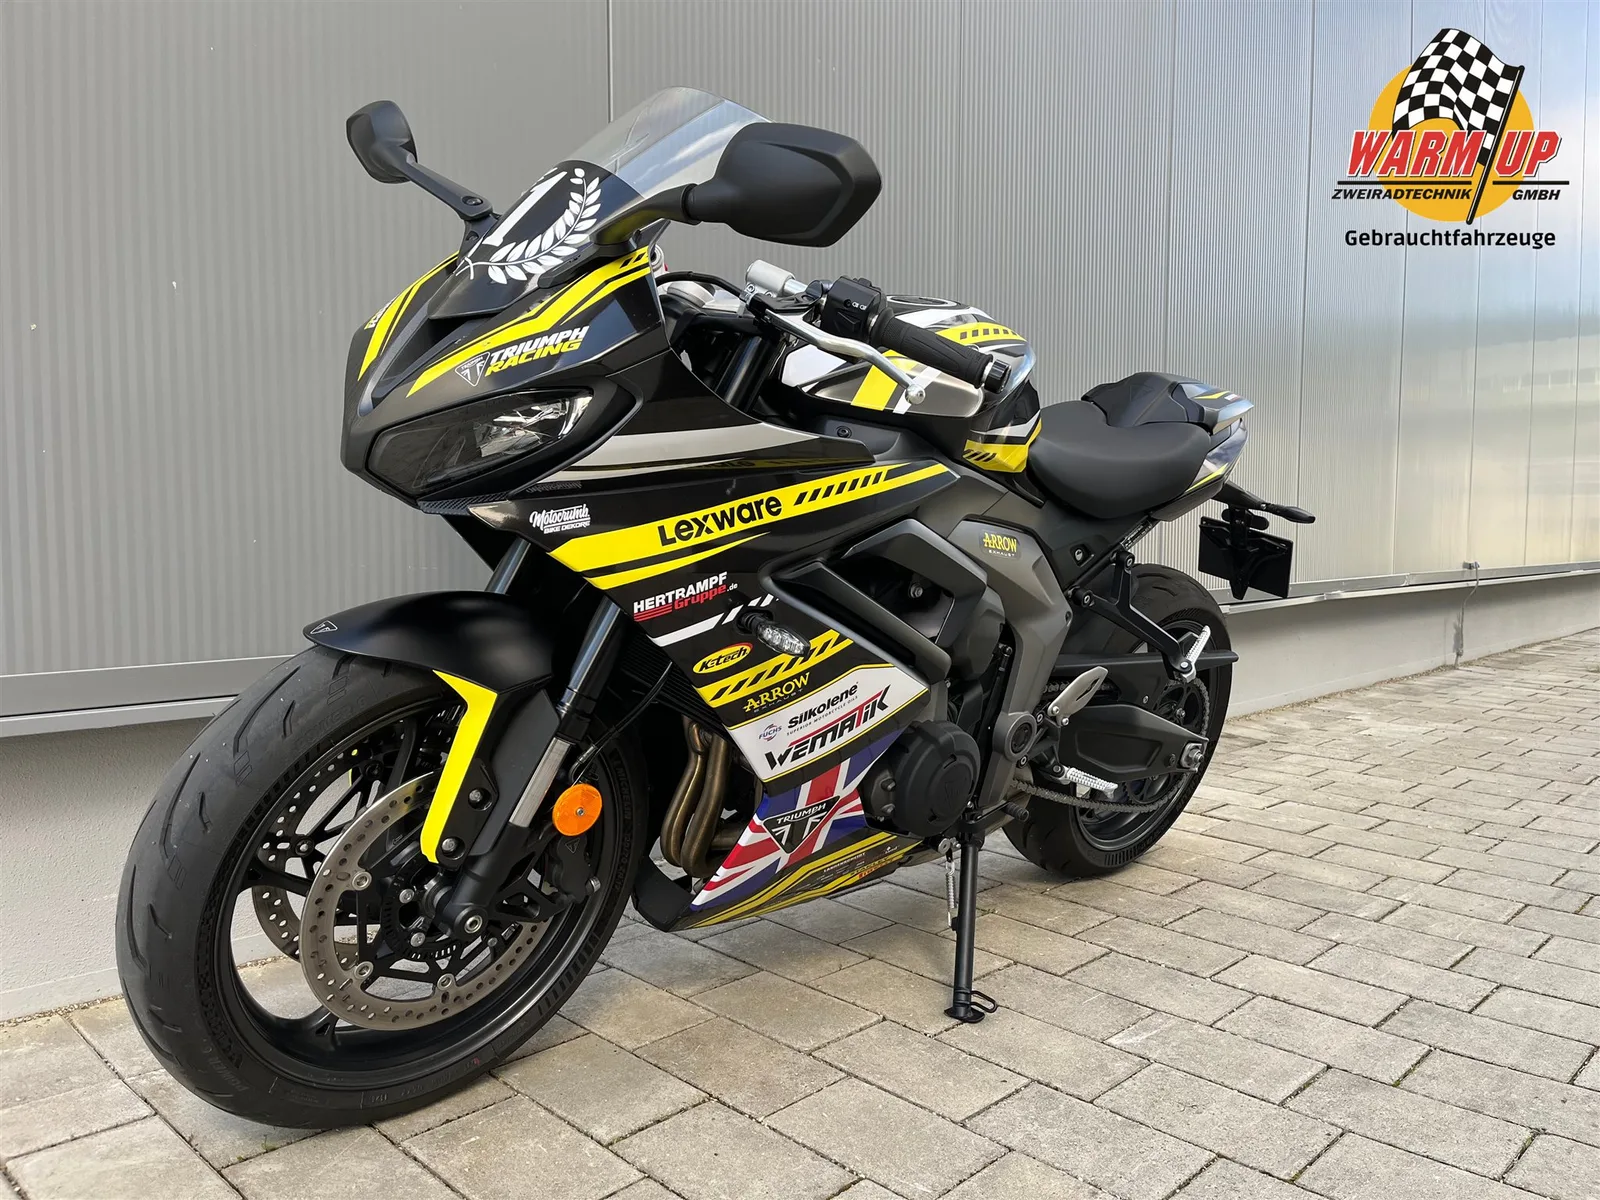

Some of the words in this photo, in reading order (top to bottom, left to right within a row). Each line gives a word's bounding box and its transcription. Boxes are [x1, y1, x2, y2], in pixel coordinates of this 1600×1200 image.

[484, 338, 583, 378] RACING
[489, 325, 590, 365] TRIUMPH
[543, 526, 561, 535] BIKE
[561, 520, 591, 531] DEKORE
[657, 496, 783, 547] Lexware
[982, 532, 1017, 553] ARROW
[633, 571, 728, 614] HERTRAMPF
[742, 671, 810, 713] ARROW
[787, 681, 859, 729] Silkolene
[758, 725, 782, 740] FUCHS
[786, 721, 812, 737] SUPERIOR
[813, 702, 846, 724] MOTORCYCLE
[776, 802, 827, 825] TRIUMPH
